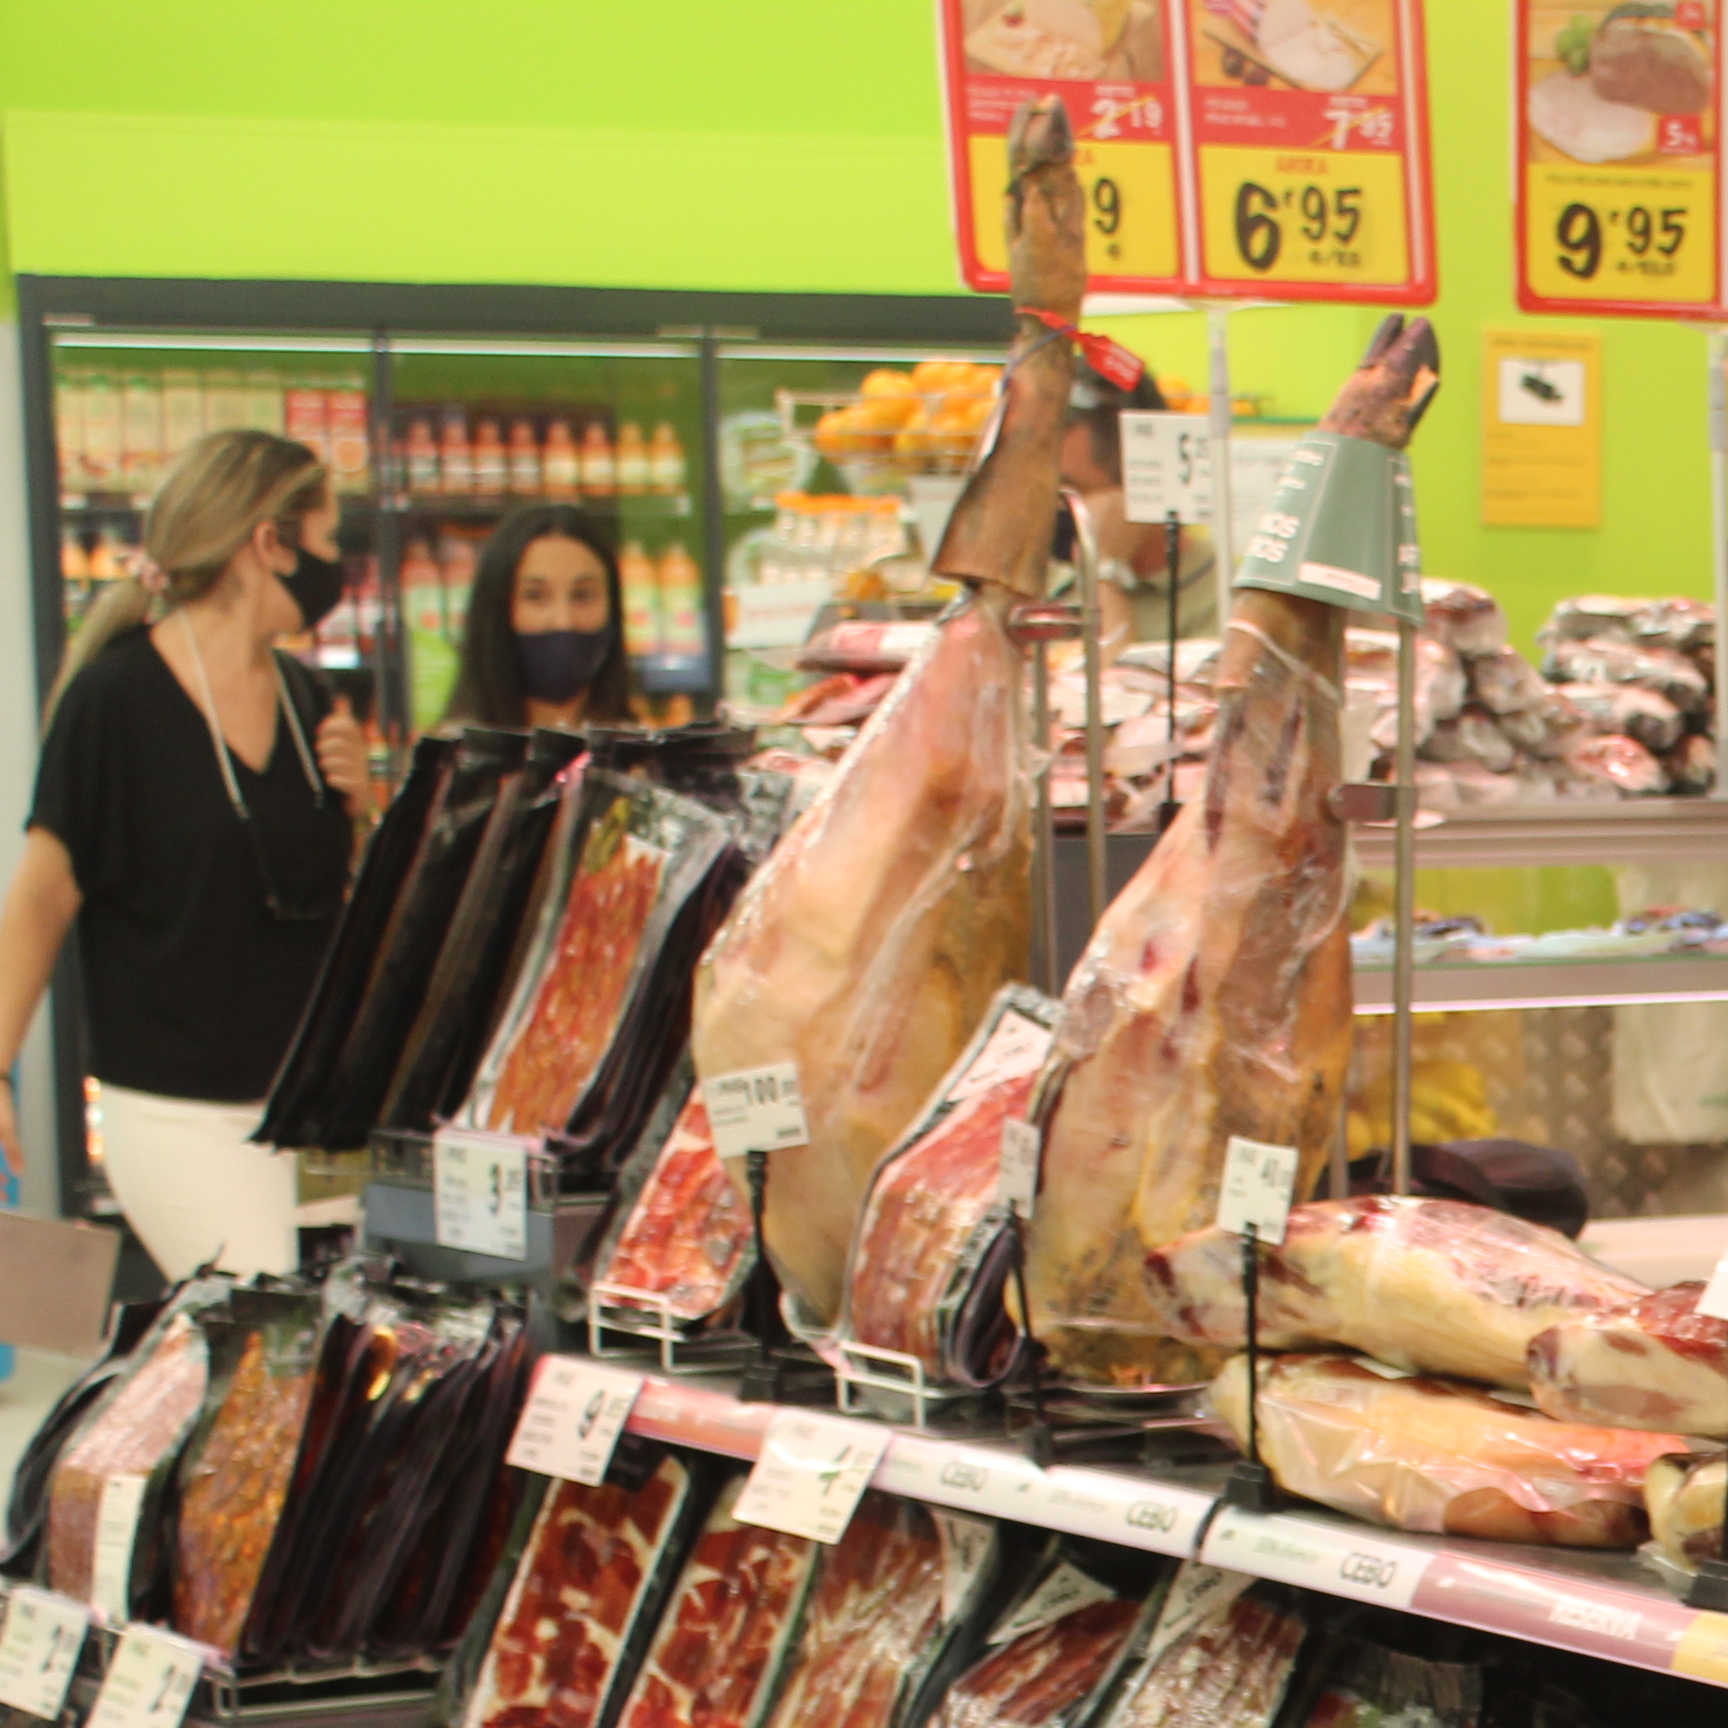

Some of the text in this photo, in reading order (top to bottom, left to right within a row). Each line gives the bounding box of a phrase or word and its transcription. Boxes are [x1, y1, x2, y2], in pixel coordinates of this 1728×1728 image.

[1235, 180, 1363, 271] 6'95
[1556, 203, 1690, 279] 9'95
[1340, 1549, 1396, 1588] CEBO
